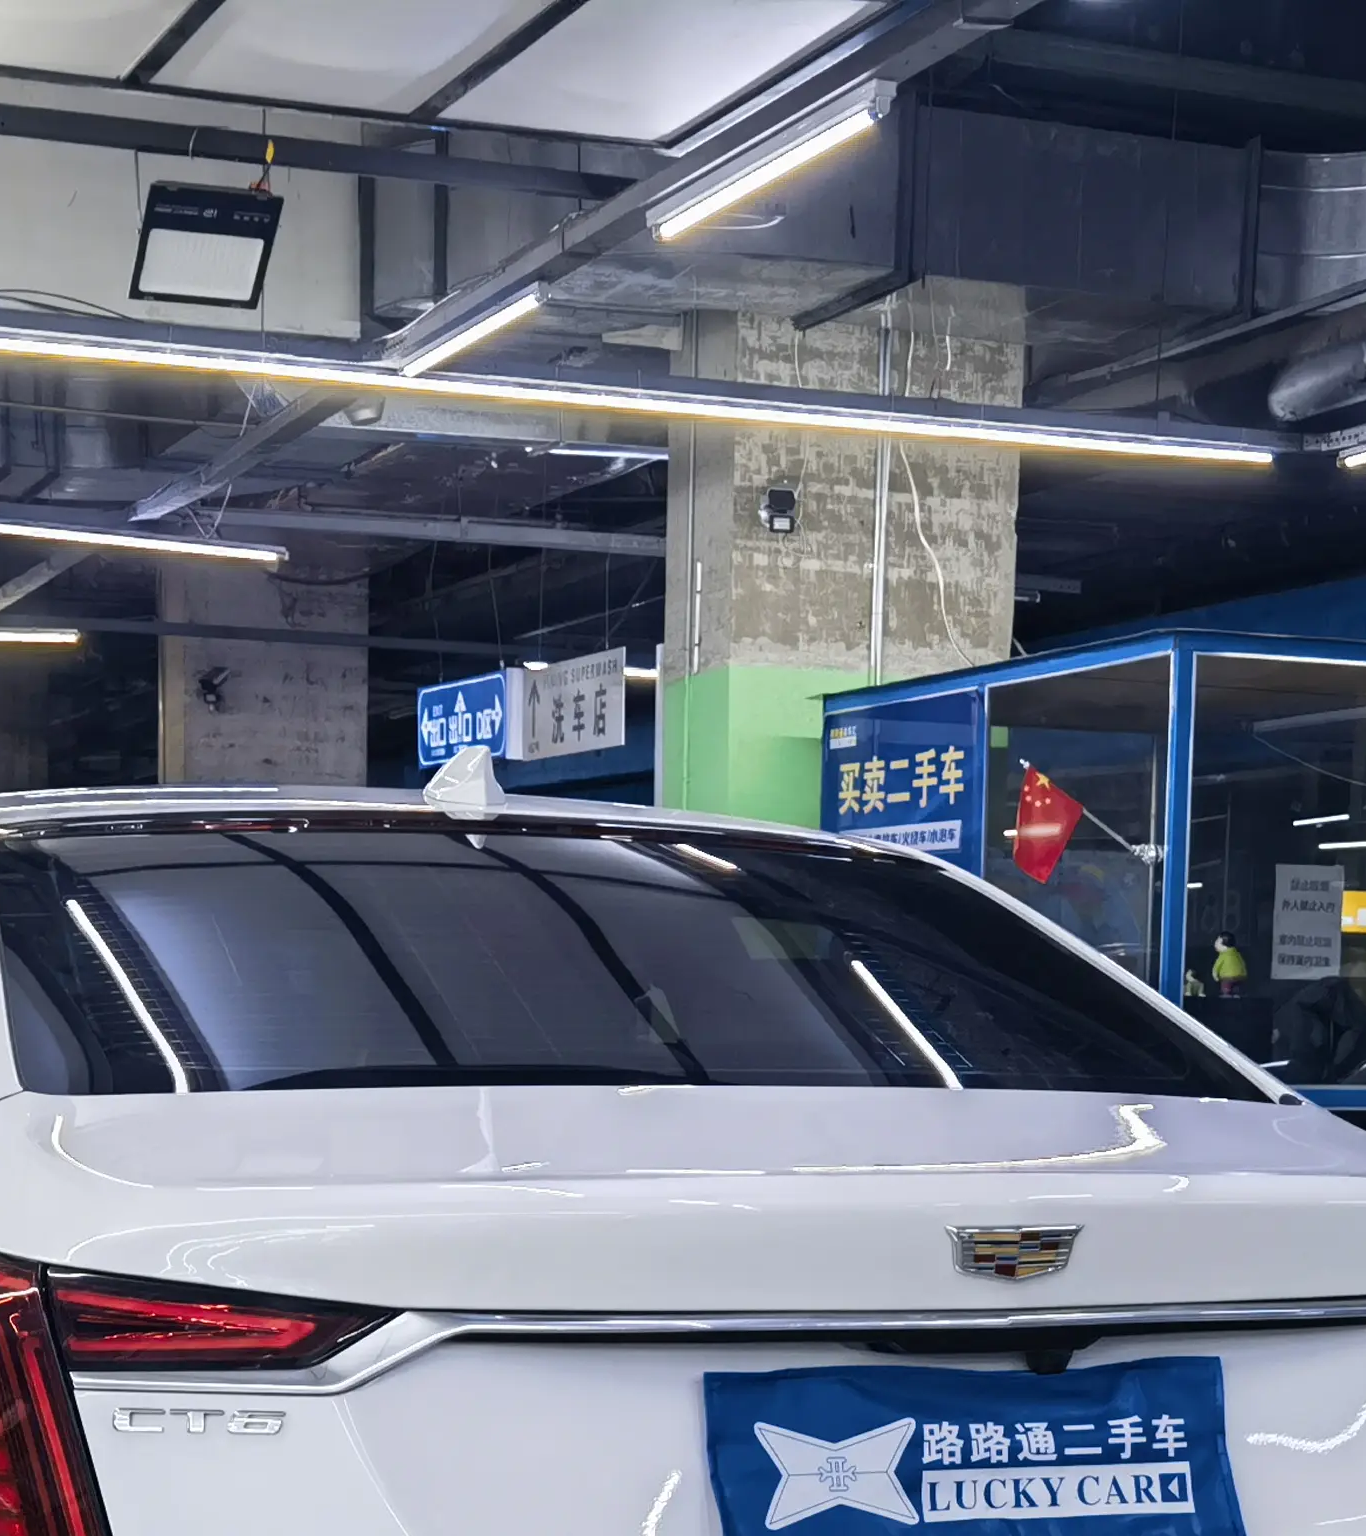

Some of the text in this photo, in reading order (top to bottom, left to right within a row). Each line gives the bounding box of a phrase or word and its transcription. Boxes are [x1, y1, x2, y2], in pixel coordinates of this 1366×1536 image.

[552, 683, 607, 744] 洗车店
[838, 745, 965, 815] 买卖二手车
[113, 1407, 286, 1435] CT6
[921, 1414, 1188, 1465] 路路通二手车
[927, 1473, 1159, 1512] LUCKY CAR
